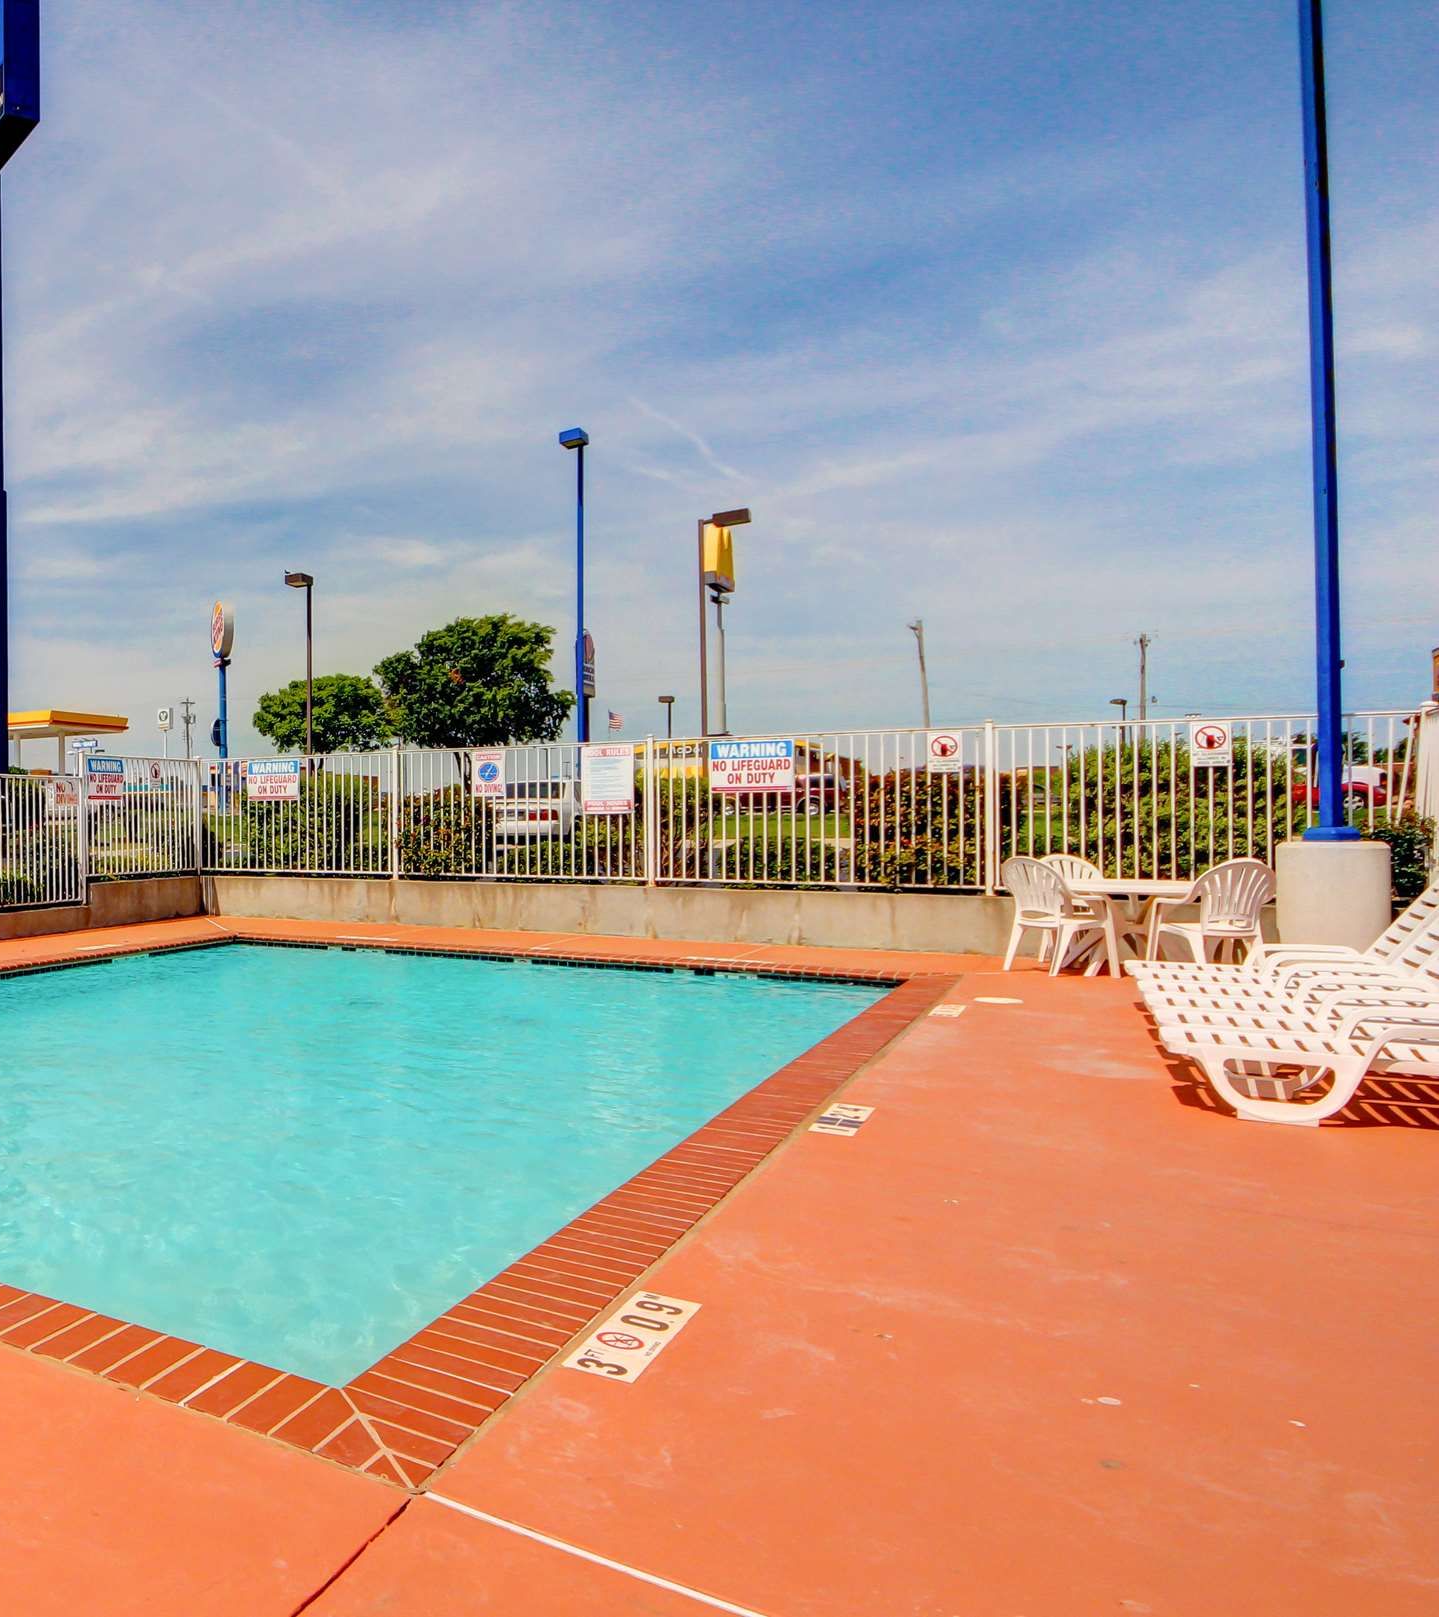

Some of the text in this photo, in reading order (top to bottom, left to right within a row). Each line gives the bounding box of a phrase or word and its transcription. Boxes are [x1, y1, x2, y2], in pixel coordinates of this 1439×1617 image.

[716, 743, 786, 757] WARNING
[90, 760, 122, 772] WARNING
[252, 762, 295, 774] WARNING
[712, 759, 791, 771] NO LIFEGUARD
[89, 774, 123, 784] NO LIFEGUARD
[248, 775, 297, 784] NO LIFEGUARD
[727, 772, 775, 784] ON DUTY
[55, 782, 66, 793] NO
[96, 785, 116, 794] ON DUTY
[257, 785, 288, 794] ON DUTY
[476, 784, 482, 793] NO
[584, 1349, 605, 1358] FT
[576, 1357, 628, 1375] 3
